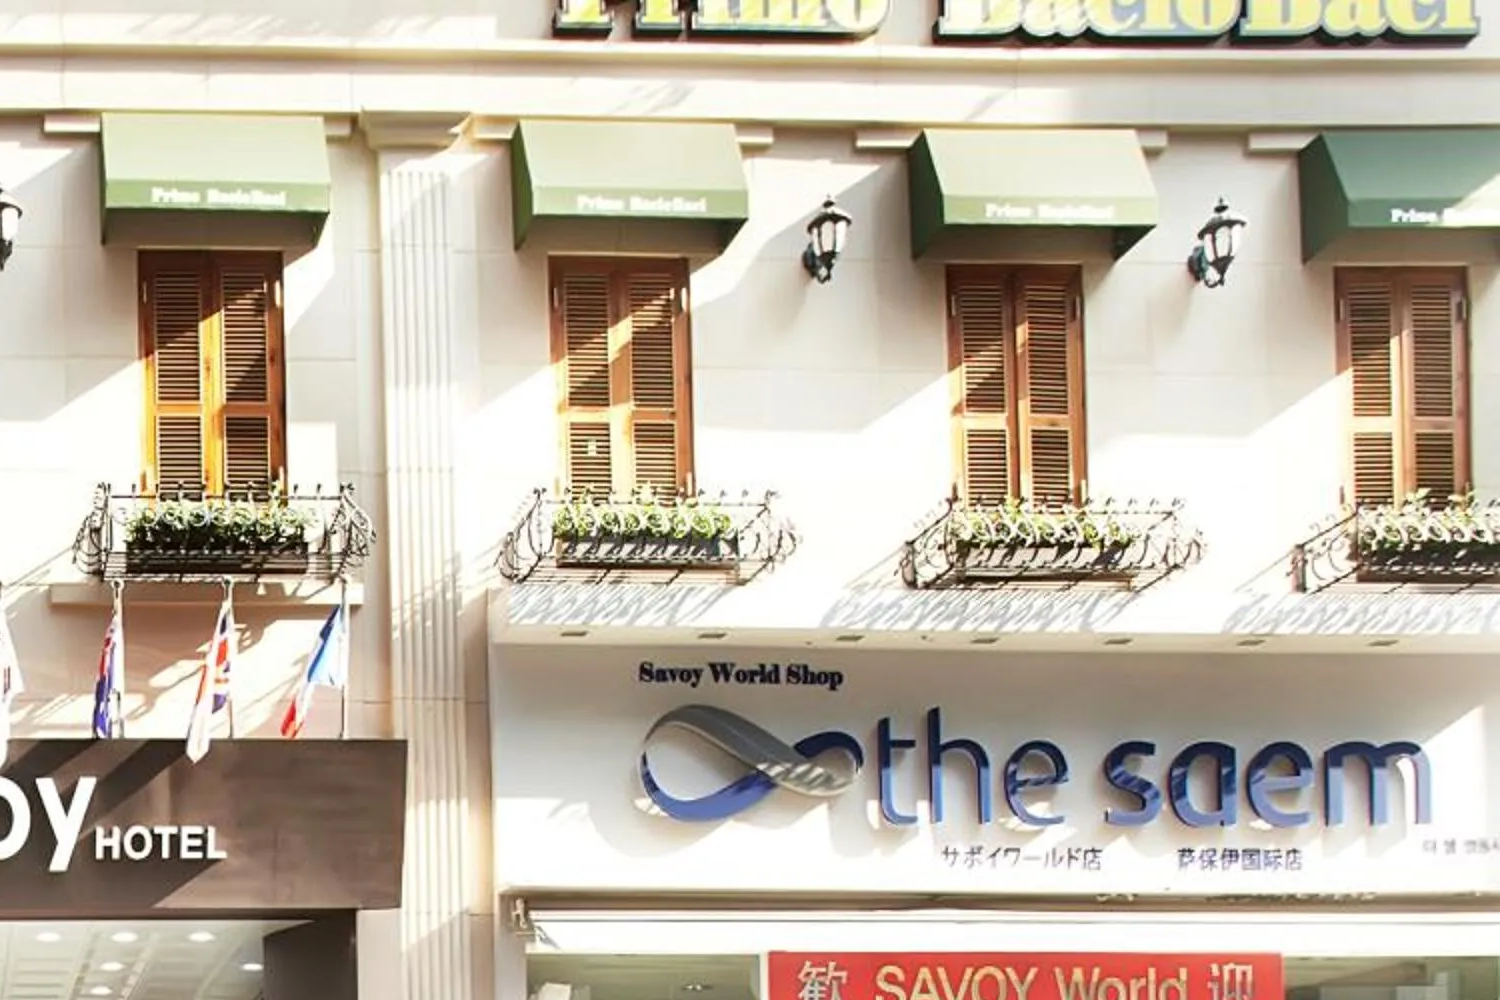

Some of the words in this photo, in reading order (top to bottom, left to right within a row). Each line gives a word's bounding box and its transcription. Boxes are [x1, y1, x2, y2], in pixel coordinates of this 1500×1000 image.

[639, 661, 704, 688] Savoy
[708, 662, 780, 685] World
[786, 663, 844, 692] Shop
[875, 706, 1071, 828] the
[1102, 735, 1434, 828] saem
[95, 825, 228, 860] HOTEL
